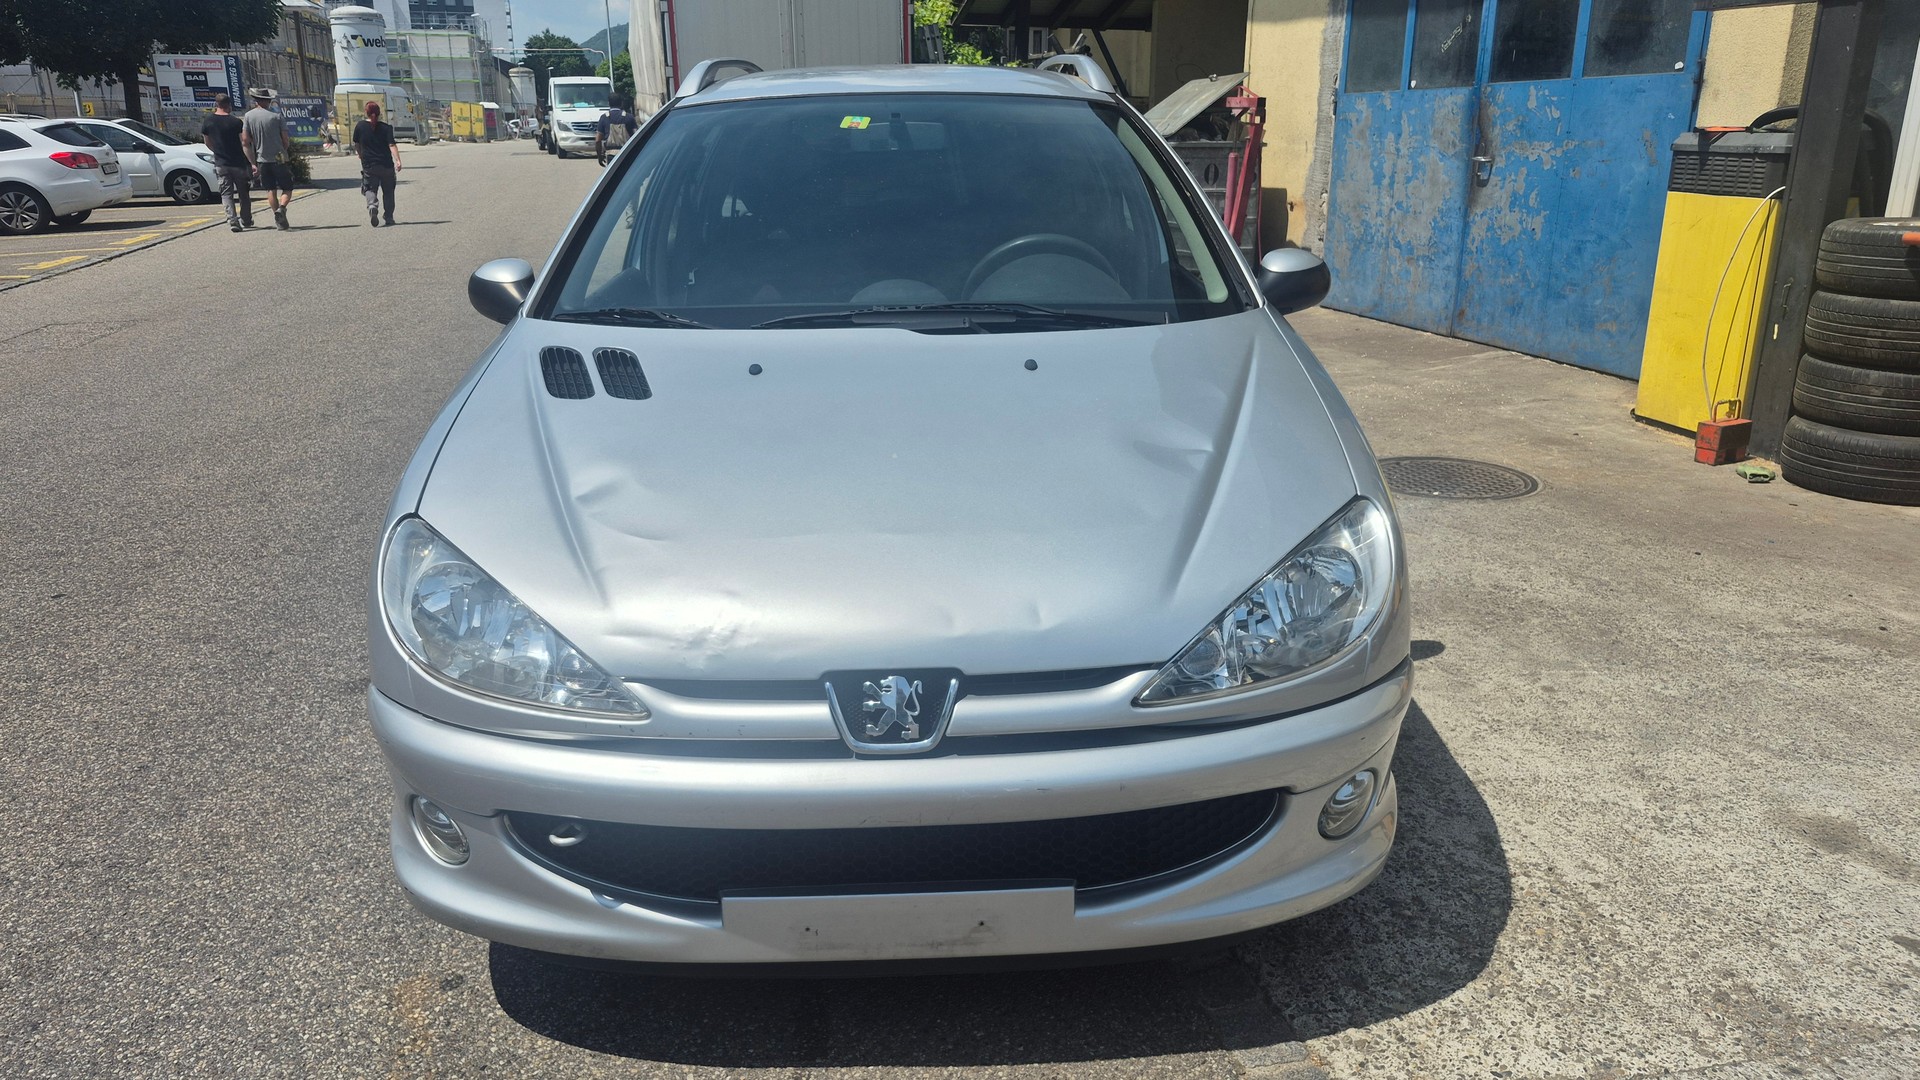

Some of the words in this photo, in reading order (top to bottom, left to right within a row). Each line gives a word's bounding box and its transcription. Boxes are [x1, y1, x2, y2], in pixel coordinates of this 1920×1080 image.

[228, 57, 236, 66] 30
[229, 67, 242, 107] BIFANGWEG
[281, 107, 310, 118] VoltNet
